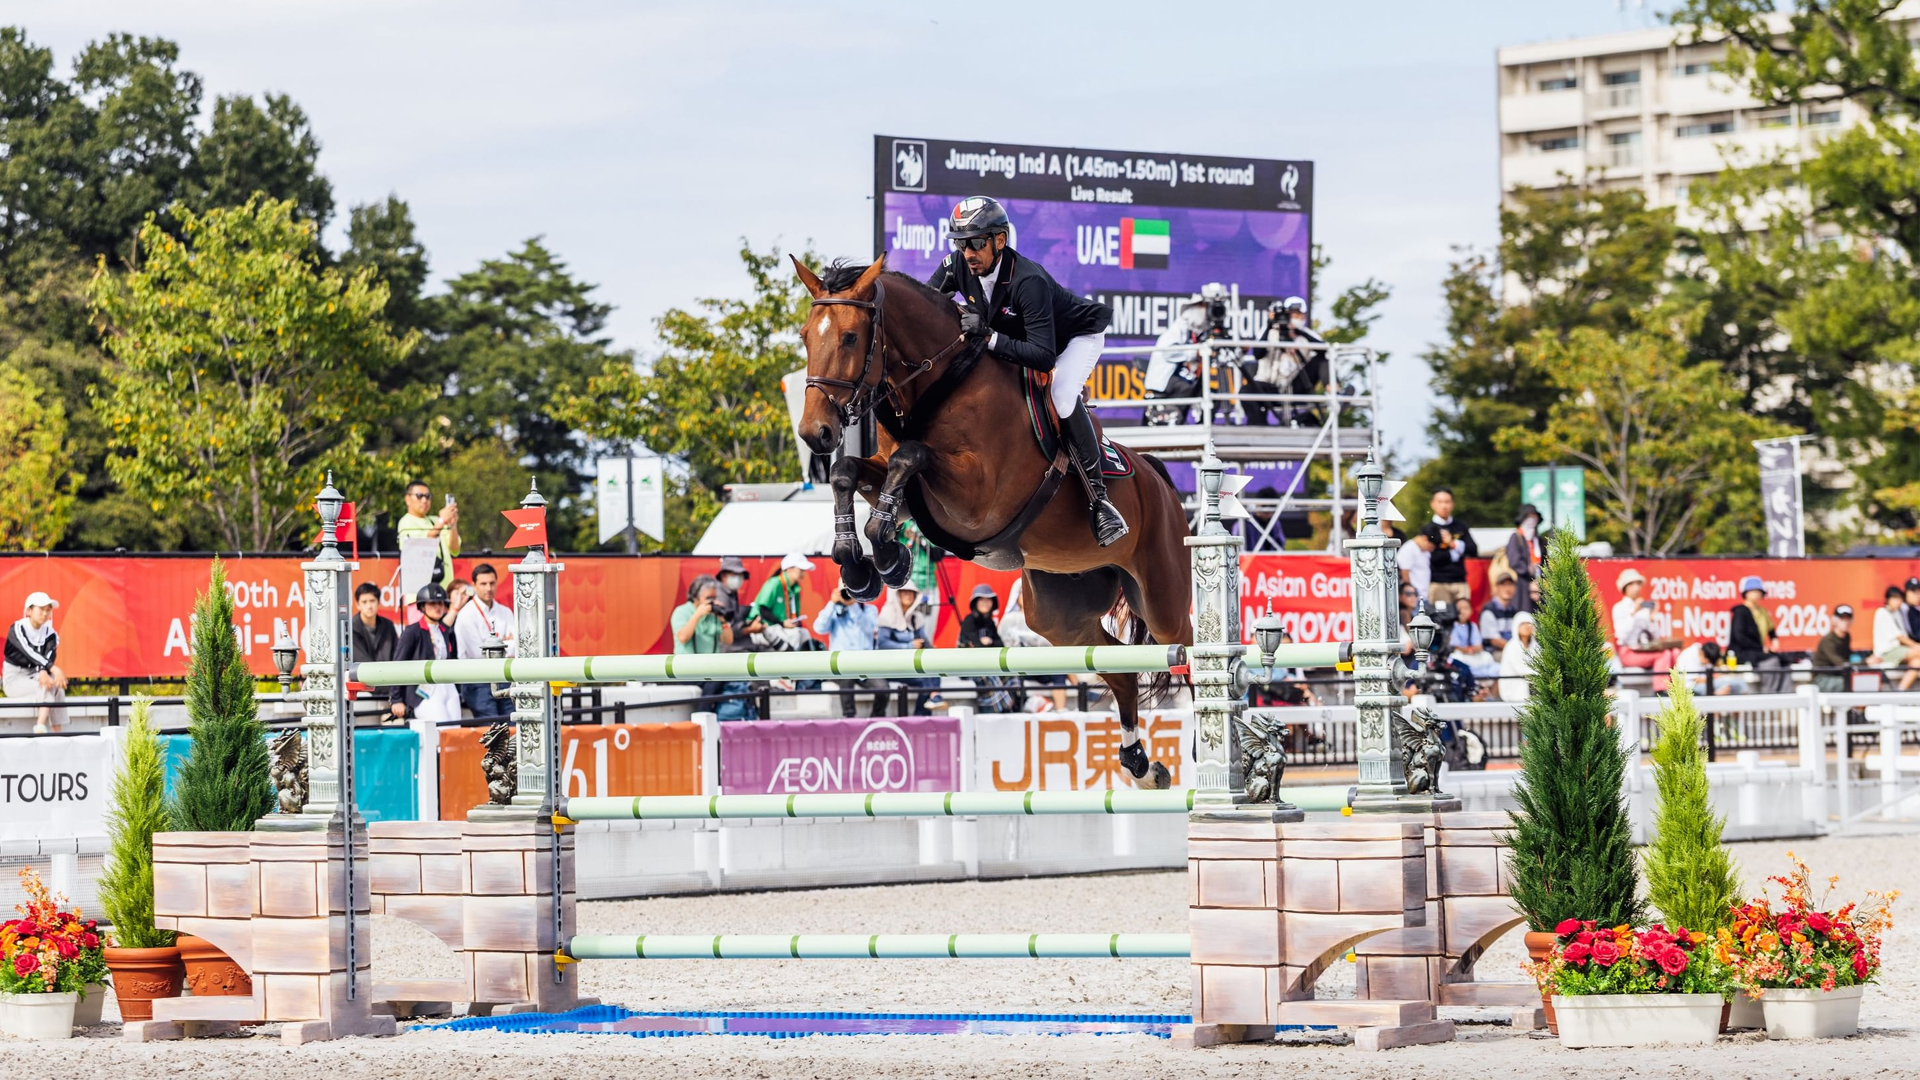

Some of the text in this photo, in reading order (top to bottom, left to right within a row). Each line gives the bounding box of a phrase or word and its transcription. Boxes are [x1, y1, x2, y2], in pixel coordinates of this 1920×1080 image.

[945, 148, 1254, 187] Jumping Ind A (1.45m-1.50m) 1st round
[1071, 184, 1134, 204] Live Result
[892, 216, 936, 259] Jump
[1077, 224, 1120, 266] UAE
[1254, 569, 1306, 598] Asian
[1650, 575, 1688, 600] 20th
[1691, 574, 1736, 600] Asian
[1775, 604, 1832, 637] 2026
[1, 772, 88, 803] TOURS
[860, 753, 907, 790] 100
